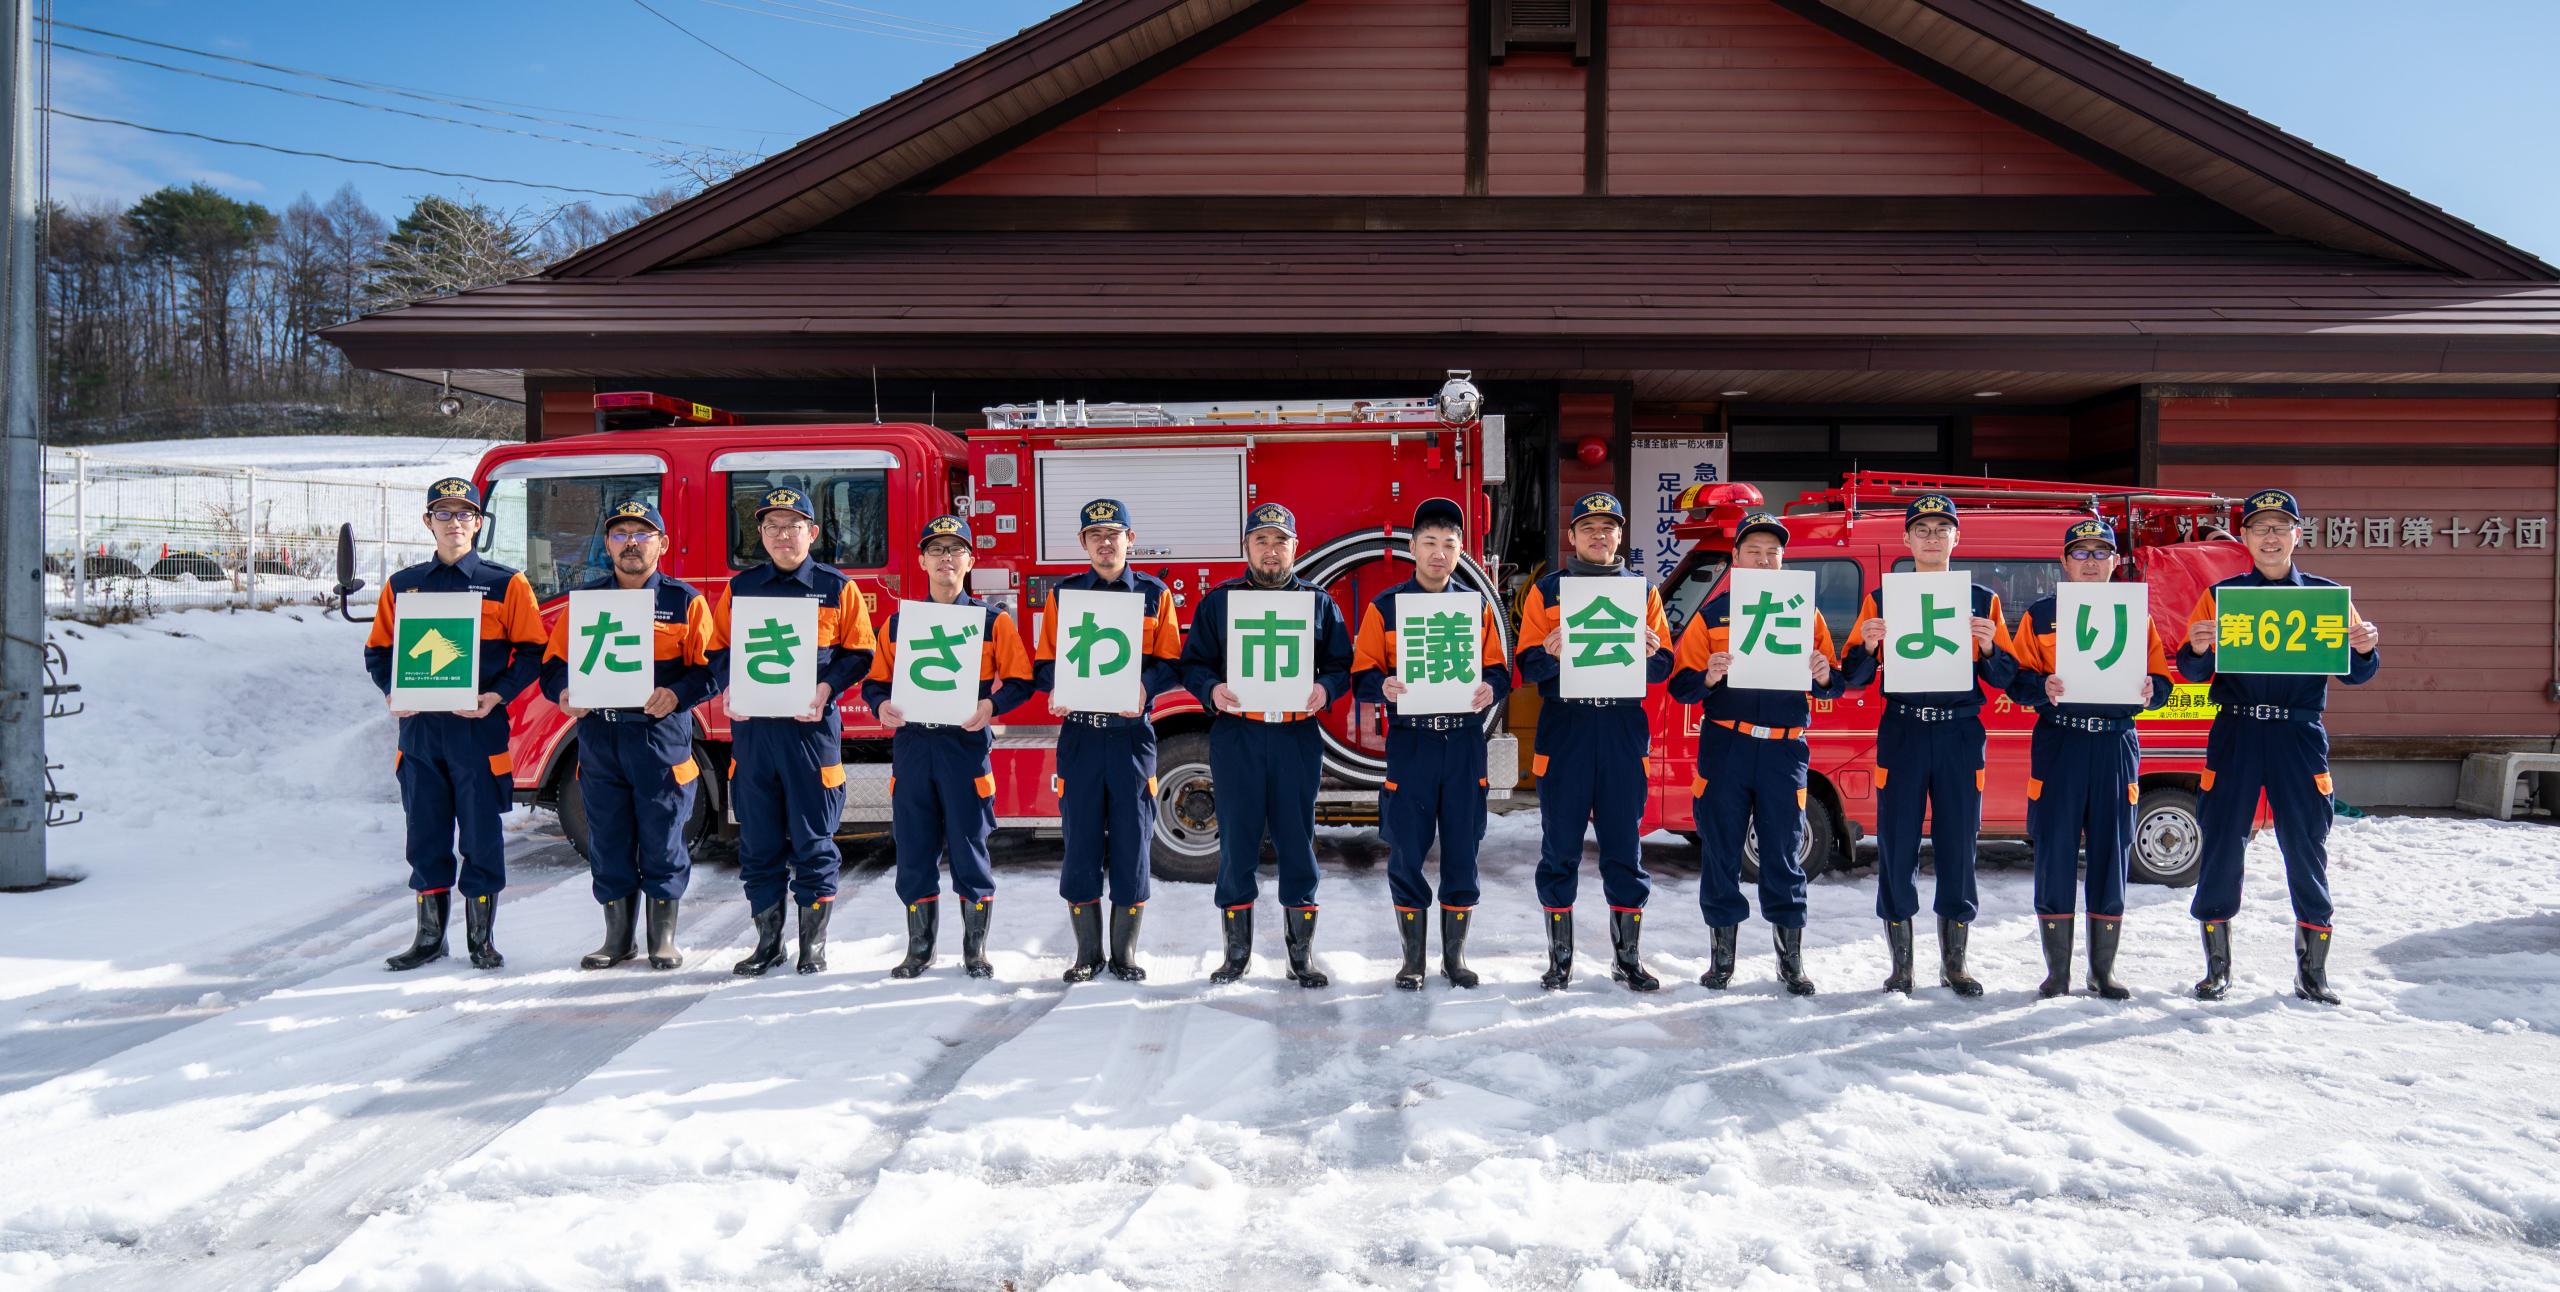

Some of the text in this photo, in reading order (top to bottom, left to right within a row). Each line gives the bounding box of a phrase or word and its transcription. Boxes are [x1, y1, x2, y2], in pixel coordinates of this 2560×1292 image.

[580, 612, 641, 675] た
[745, 618, 800, 684] き
[1067, 612, 1131, 677] わ
[1235, 611, 1306, 681] 市
[1404, 612, 1473, 682] 議
[1566, 595, 1638, 668] 会
[1739, 590, 1804, 655] だ
[1896, 593, 1960, 659] よ
[2076, 604, 2128, 670] り
[2219, 610, 2348, 651] 第62号
[909, 625, 978, 691] ざ
